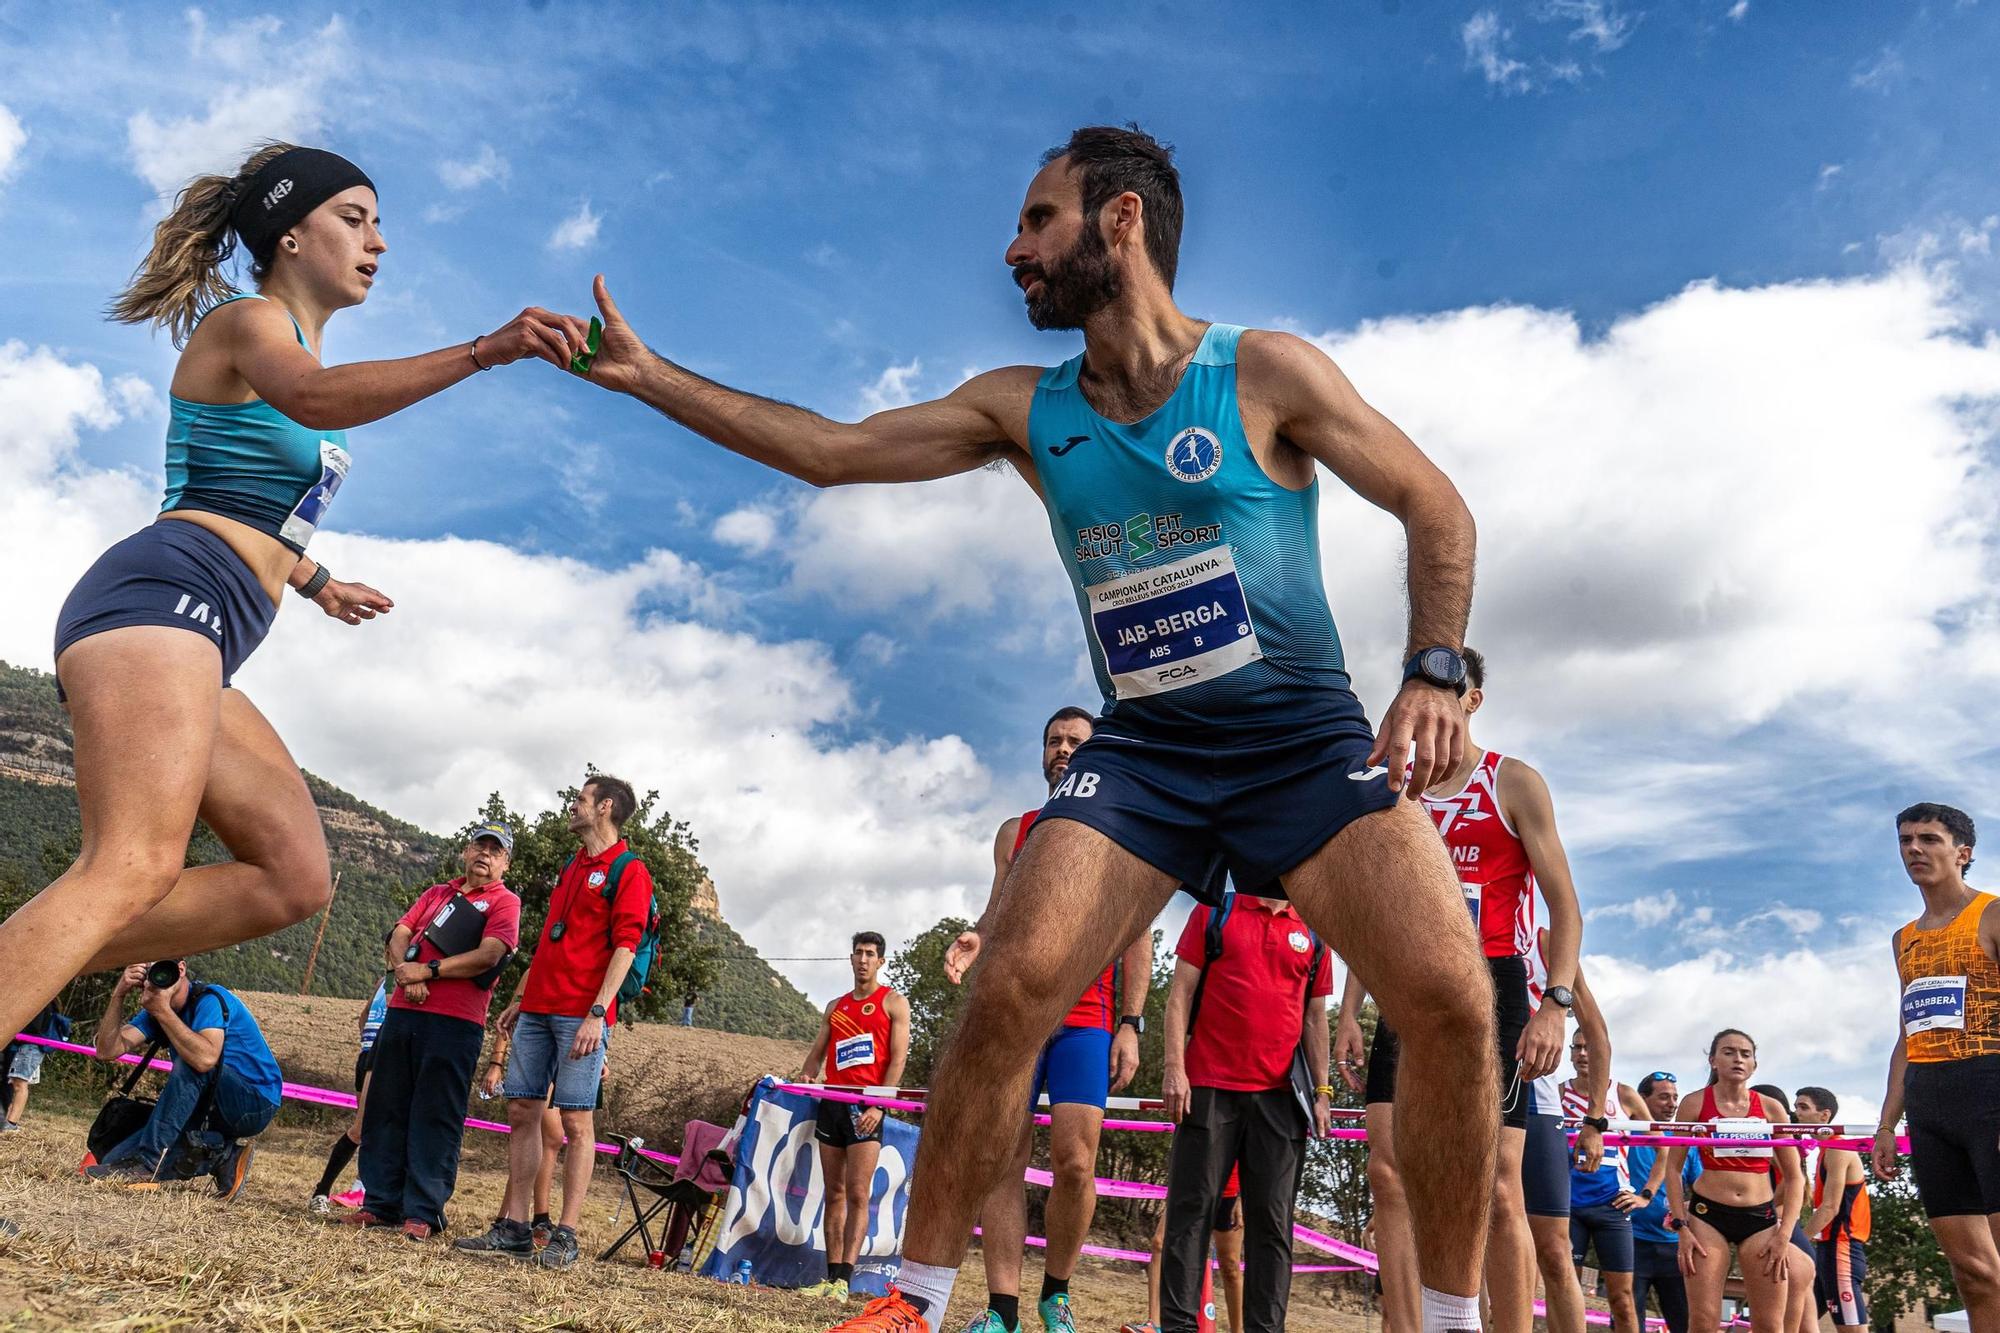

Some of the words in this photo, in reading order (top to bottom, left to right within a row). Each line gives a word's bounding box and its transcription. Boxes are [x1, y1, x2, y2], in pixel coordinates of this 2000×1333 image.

[1078, 523, 1121, 545] FISIO
[1154, 513, 1182, 532] FIT
[1157, 523, 1222, 548] SPORT
[1075, 539, 1122, 562] SALUT
[1098, 580, 1150, 602] CAMPIONAT
[1152, 558, 1220, 587] CATALUNYA
[1112, 597, 1125, 607] CROS
[1125, 592, 1150, 604] RELLEUS
[1150, 584, 1176, 597] MIXTOS
[1177, 578, 1194, 589] 2023
[1117, 601, 1228, 646] JAB-BERGA
[1149, 644, 1171, 659] ABS
[1193, 636, 1204, 647] B
[1157, 665, 1197, 682] FCA
[1914, 993, 1957, 1009] BARBERÀ
